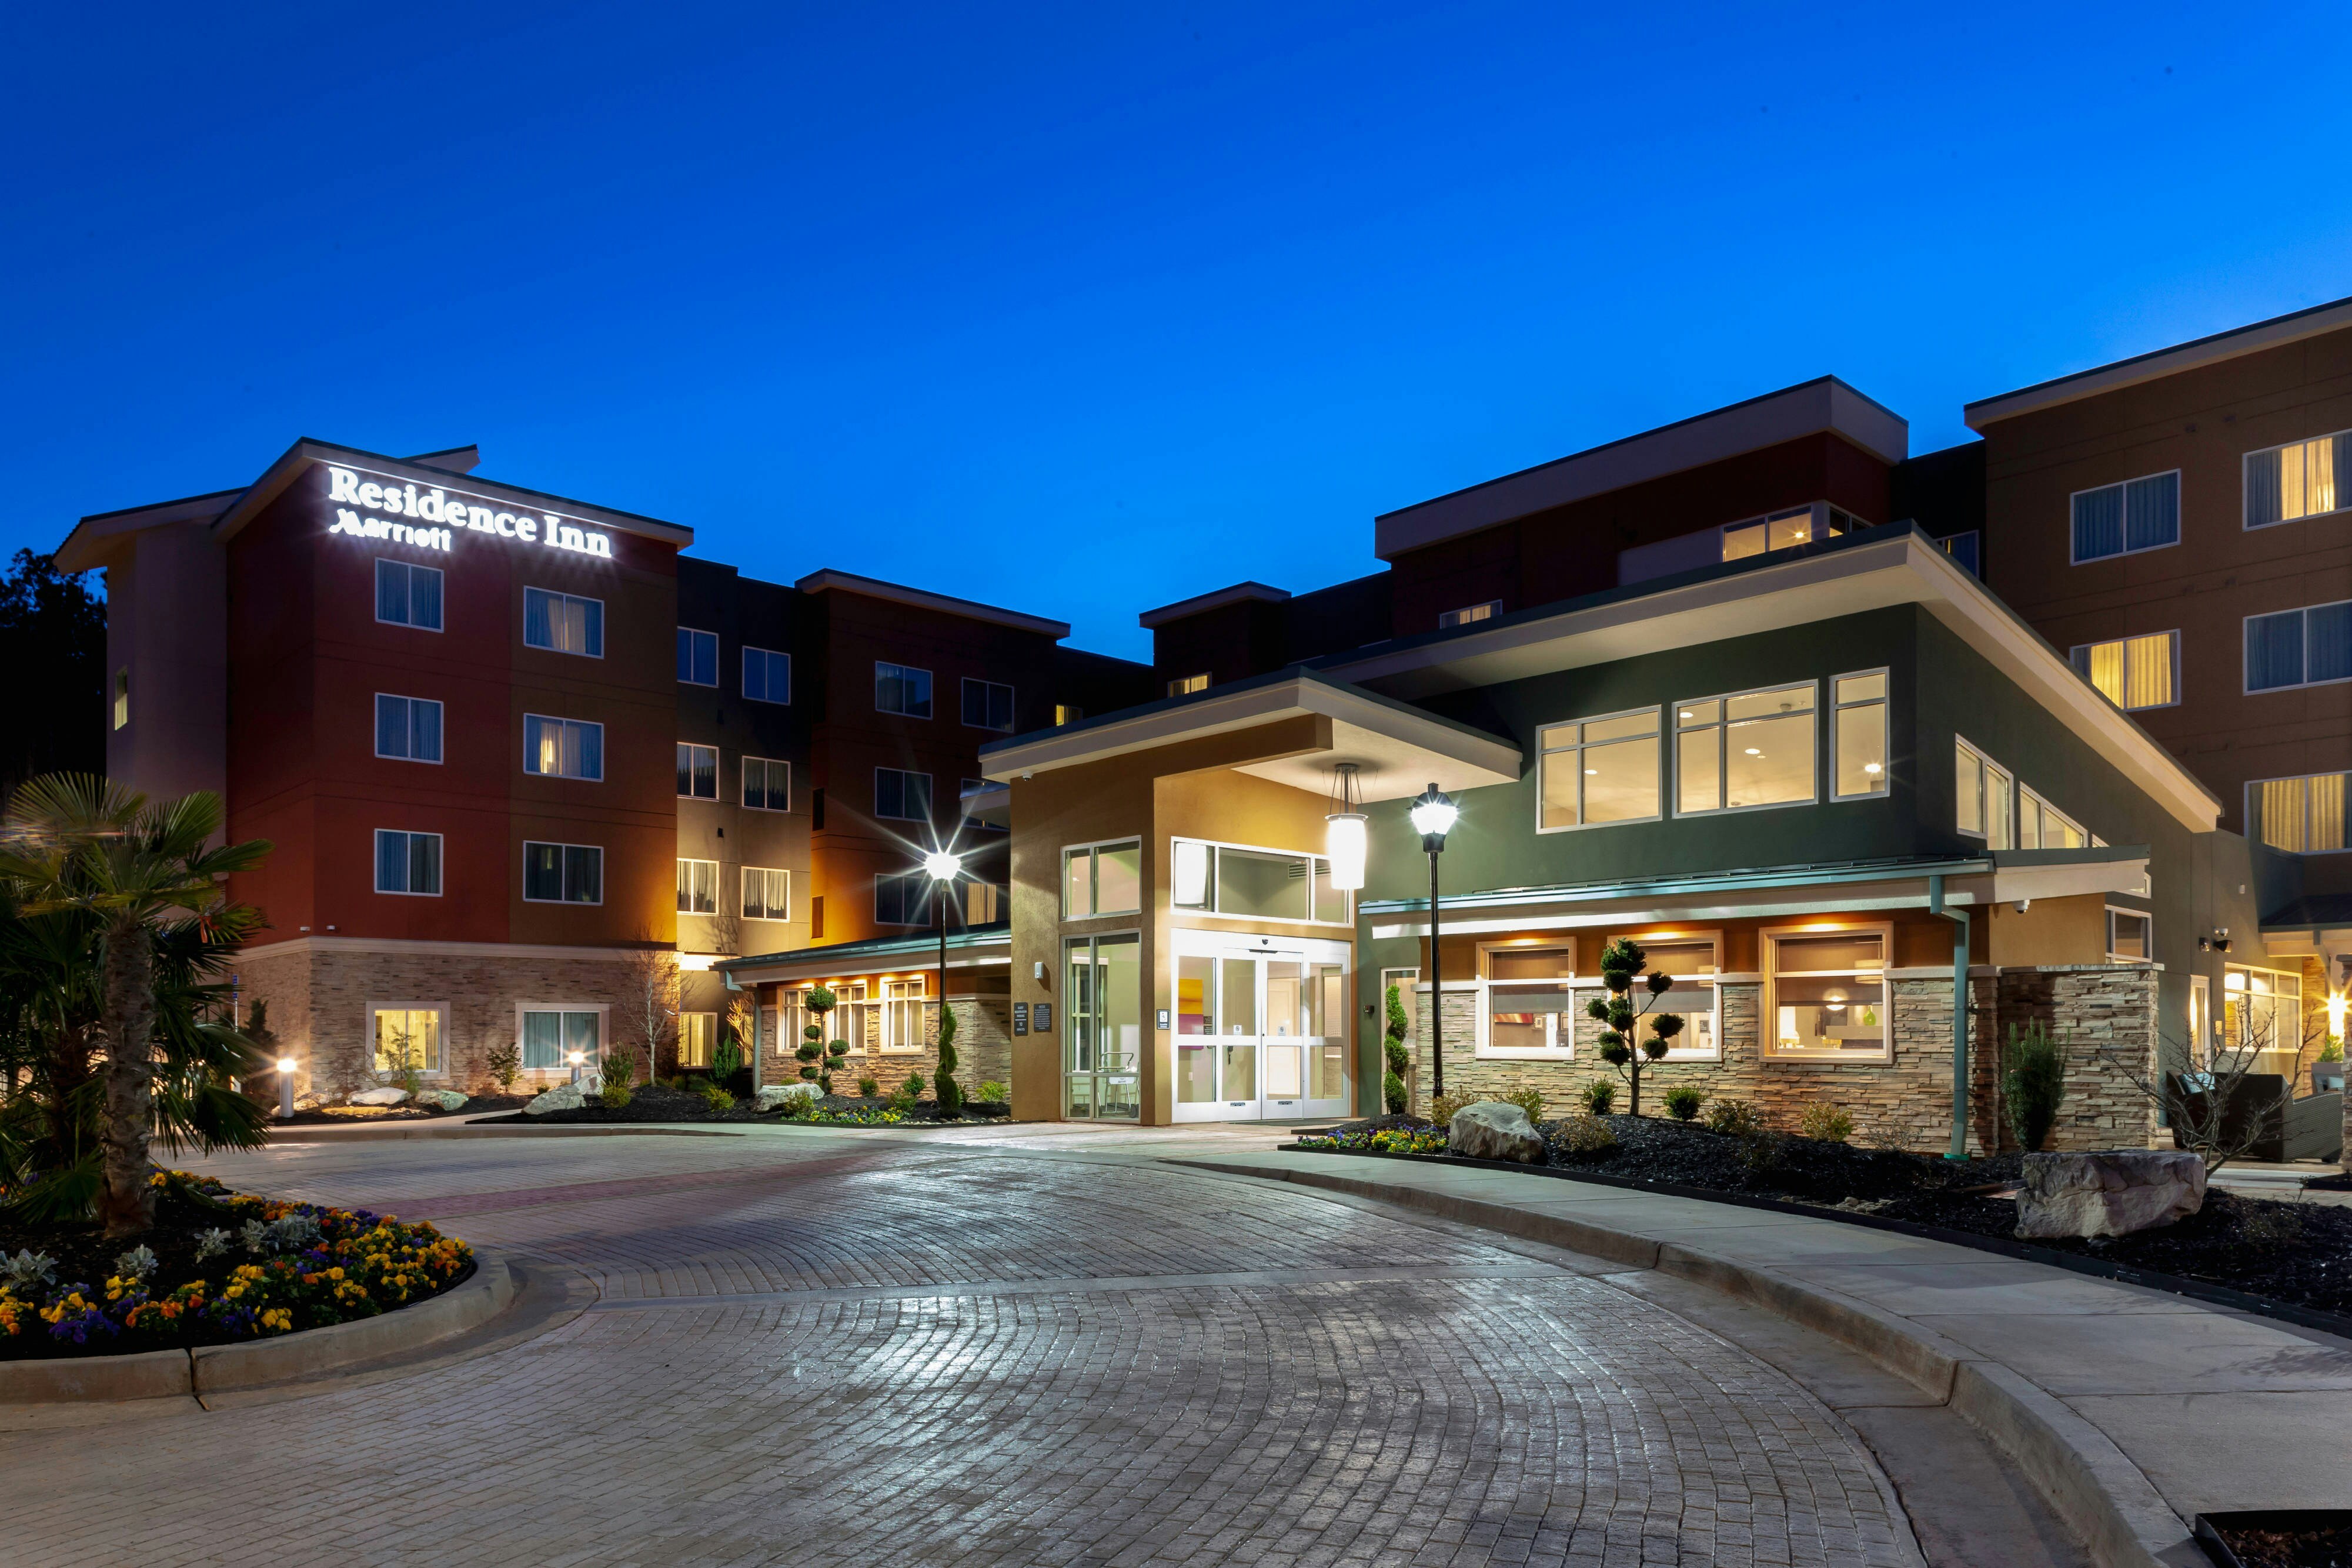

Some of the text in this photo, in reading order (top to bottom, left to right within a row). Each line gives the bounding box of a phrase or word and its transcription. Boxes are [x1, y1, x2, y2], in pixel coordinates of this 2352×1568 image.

[329, 467, 612, 558] Residence Inn
[329, 509, 452, 551] Marriott
